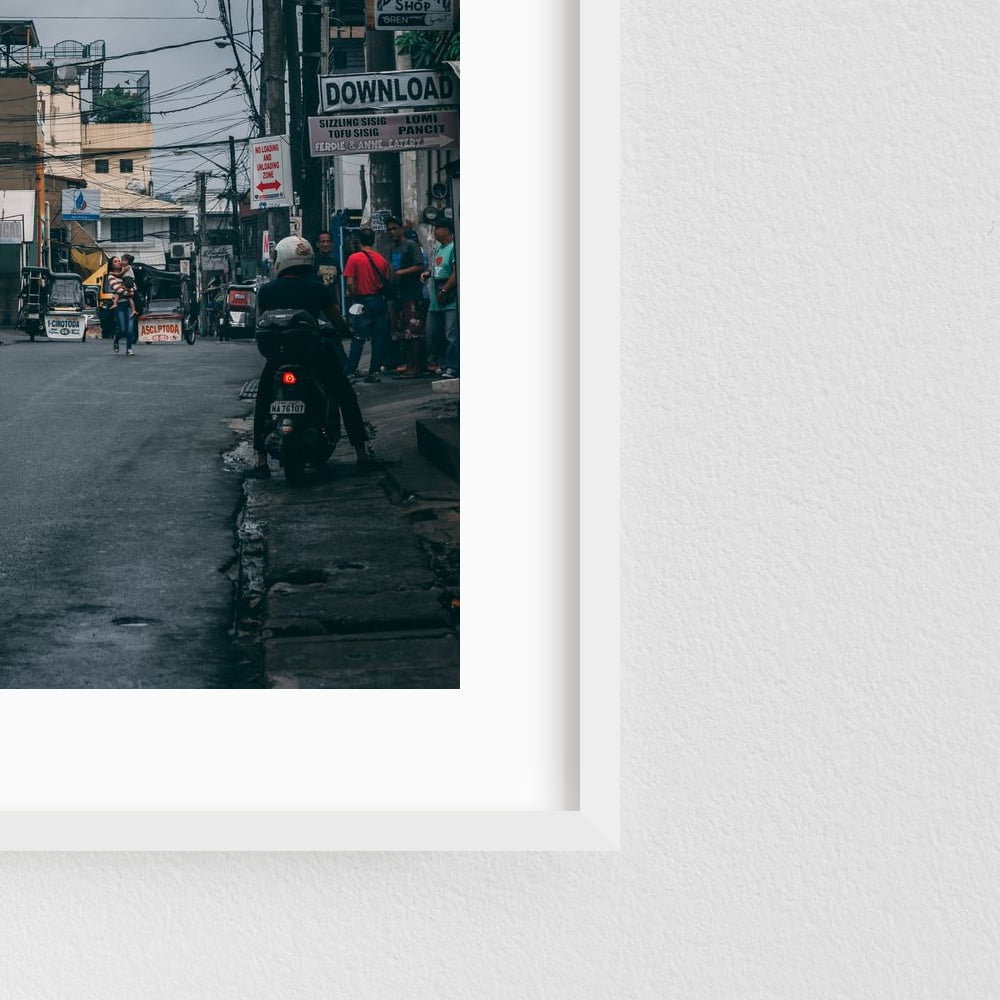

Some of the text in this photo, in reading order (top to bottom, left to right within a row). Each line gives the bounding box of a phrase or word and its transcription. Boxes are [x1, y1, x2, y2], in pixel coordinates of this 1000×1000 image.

[396, 0, 430, 12] SHOP
[383, 15, 408, 25] OPEN
[326, 76, 454, 106] DOWNLOAD
[319, 117, 387, 129] SIZZLING SISIG
[406, 114, 438, 125] LOMI
[328, 128, 379, 139] TOFU SISIG
[398, 125, 446, 136] PANCIT
[262, 144, 279, 153] LOADING
[315, 141, 347, 153] FERDIE
[349, 141, 355, 151] &
[389, 138, 424, 149] EATERY
[257, 162, 279, 171] UNLOADING
